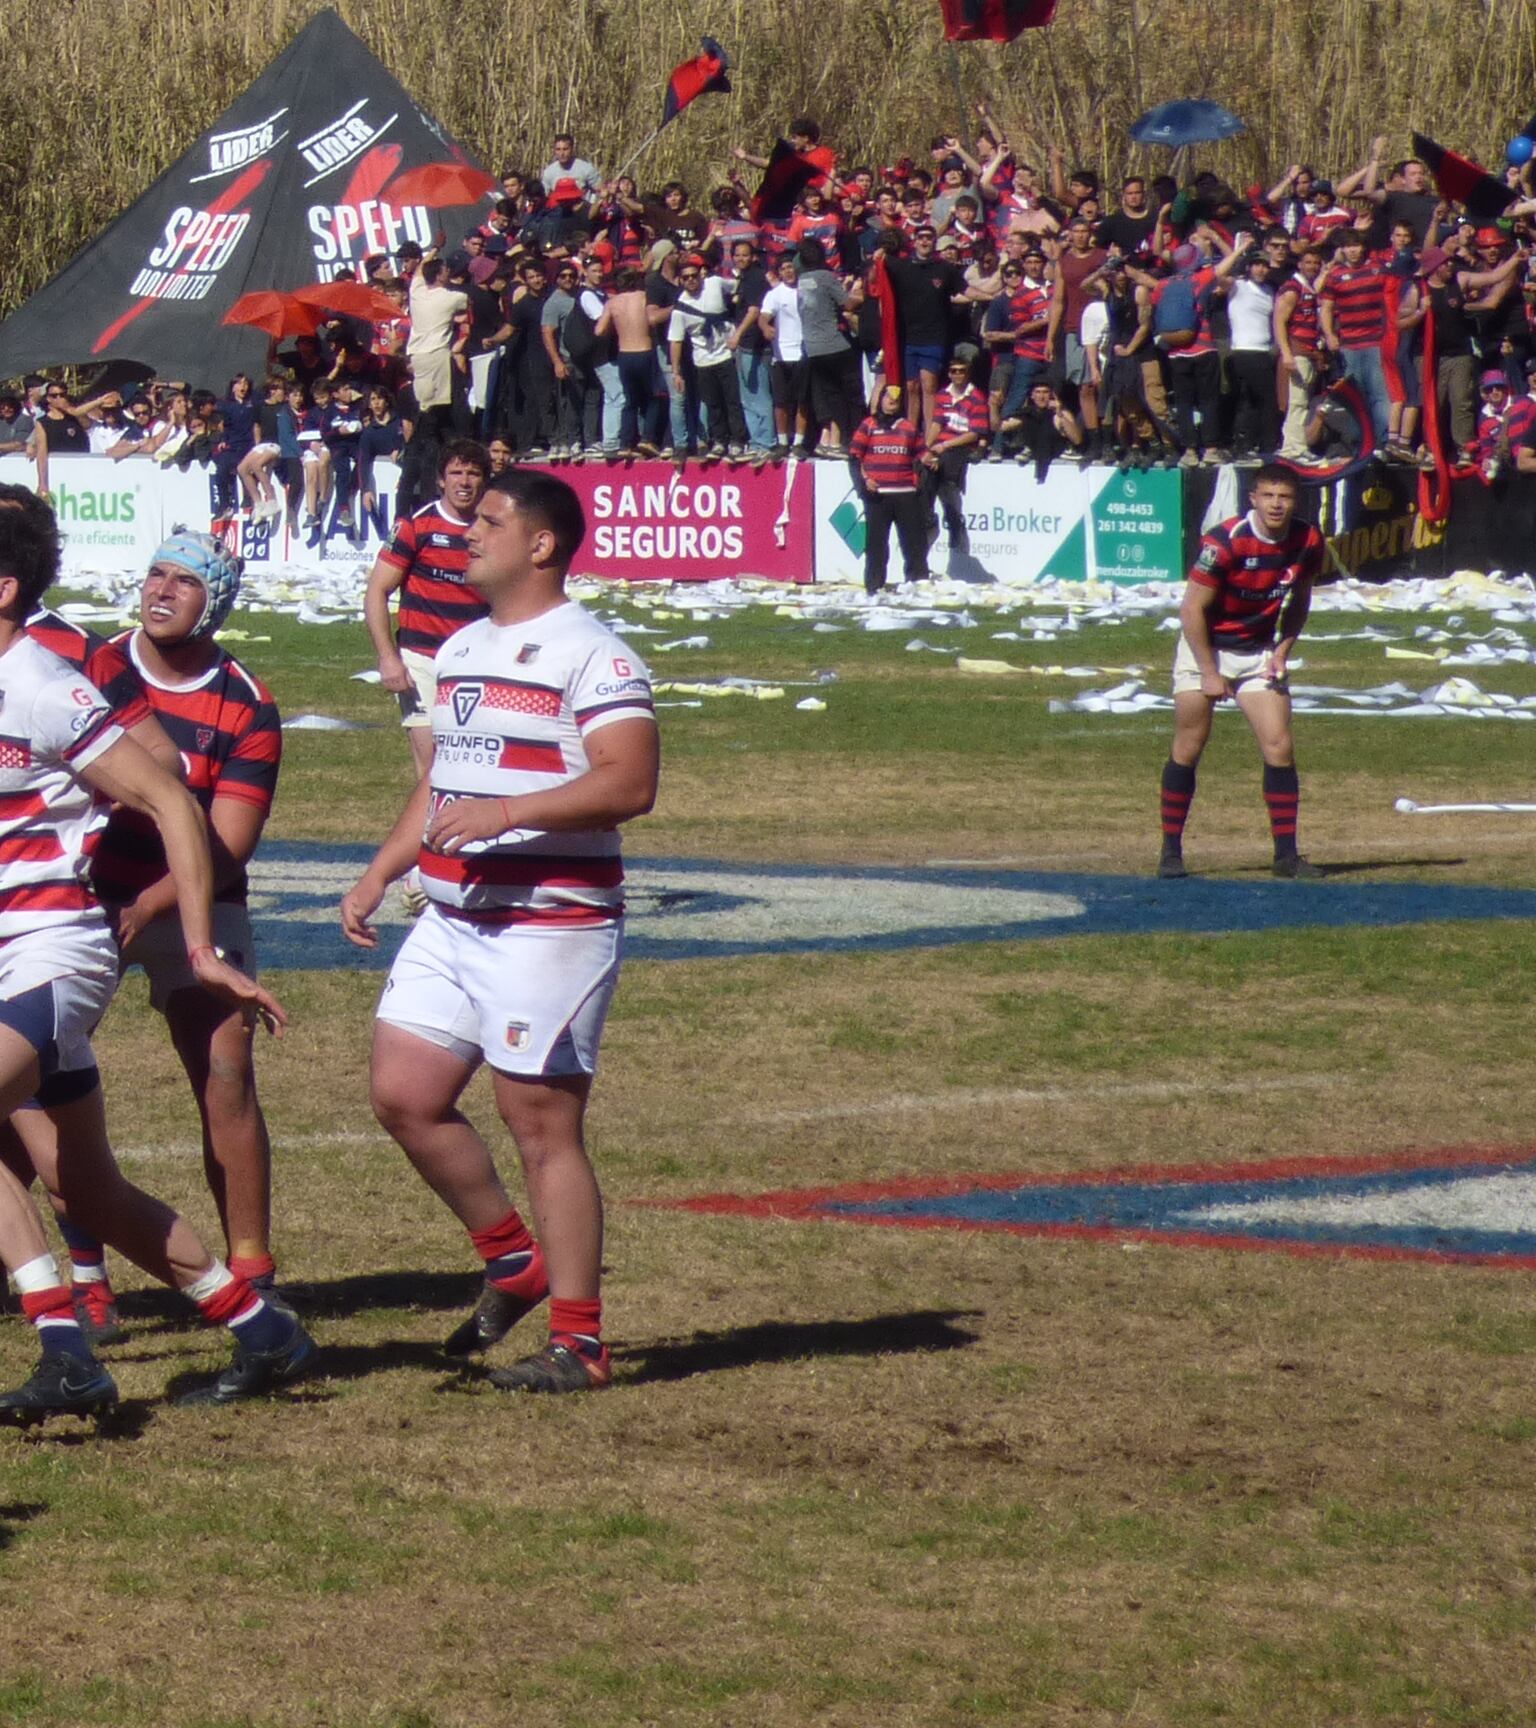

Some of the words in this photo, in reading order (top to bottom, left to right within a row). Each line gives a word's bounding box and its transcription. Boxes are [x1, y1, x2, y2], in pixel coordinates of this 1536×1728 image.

[210, 124, 275, 172] LIDER
[302, 117, 375, 173] LIDER
[149, 207, 251, 273] SPEED
[129, 268, 217, 300] UNLIMITED
[594, 485, 743, 518] SANCOR
[595, 526, 743, 559] SEGUROS
